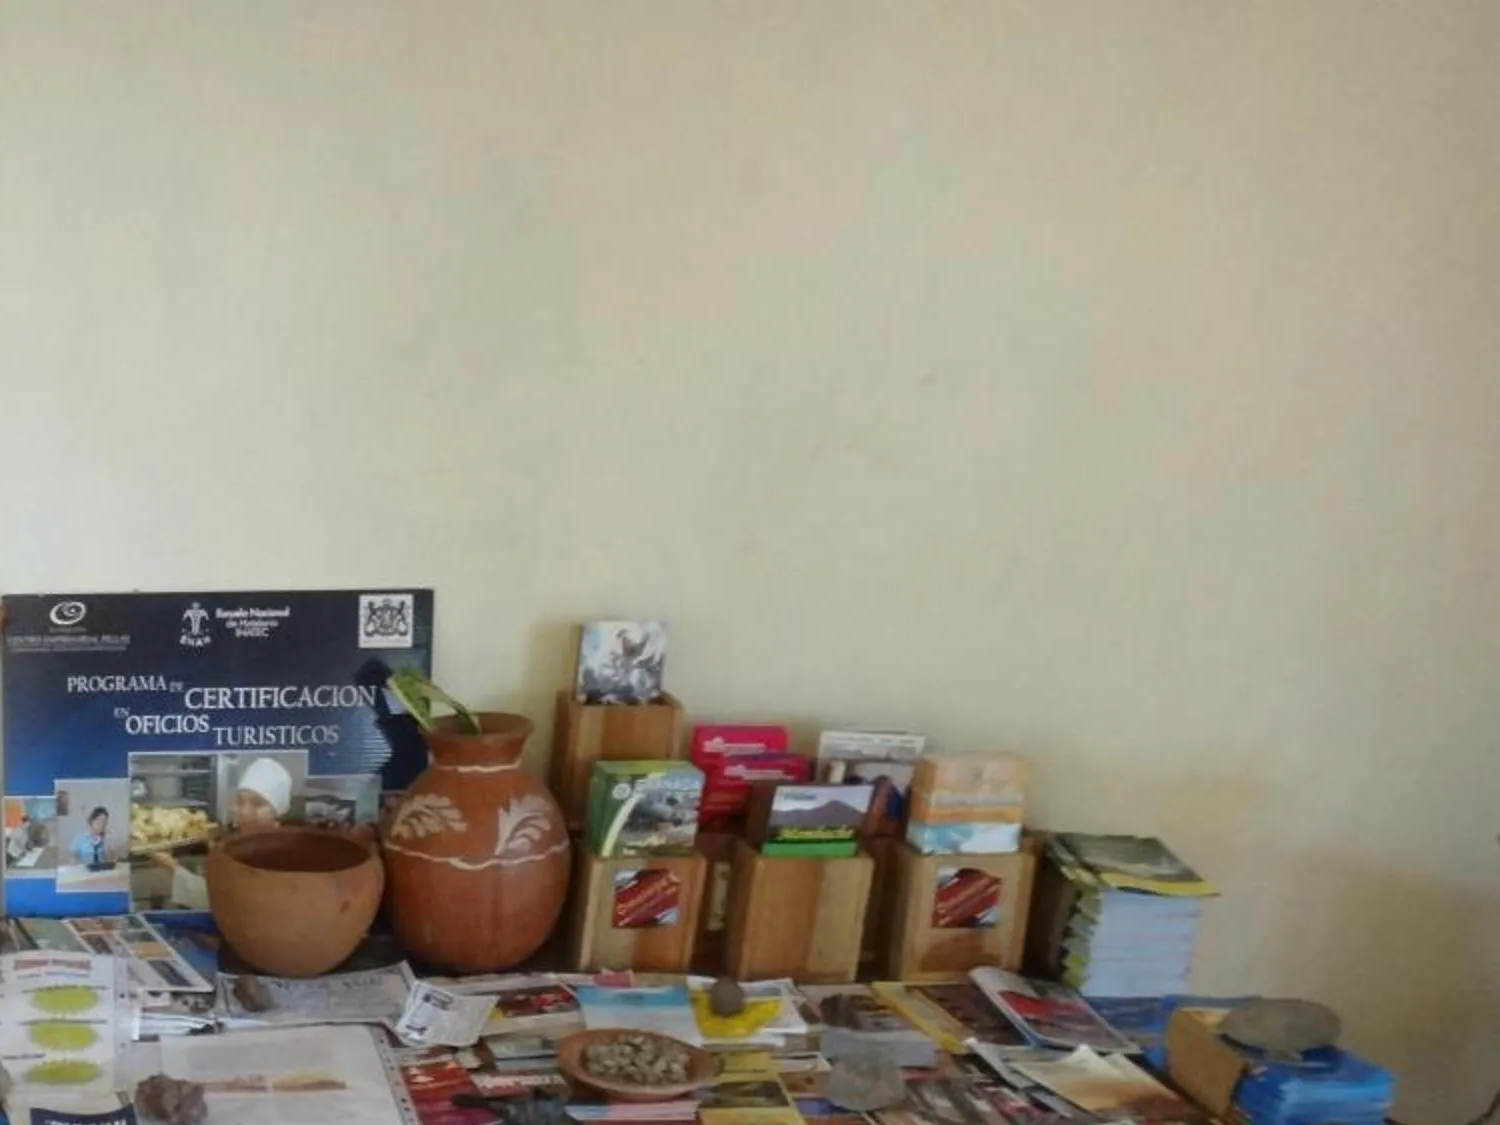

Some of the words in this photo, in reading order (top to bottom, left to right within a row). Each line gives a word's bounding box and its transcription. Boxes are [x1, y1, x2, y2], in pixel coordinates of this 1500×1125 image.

[67, 674, 167, 694] PROGRAMA
[184, 685, 377, 711] CERTIFICACION
[125, 713, 210, 736] OFICIOS
[211, 725, 340, 747] TURISTICOS
